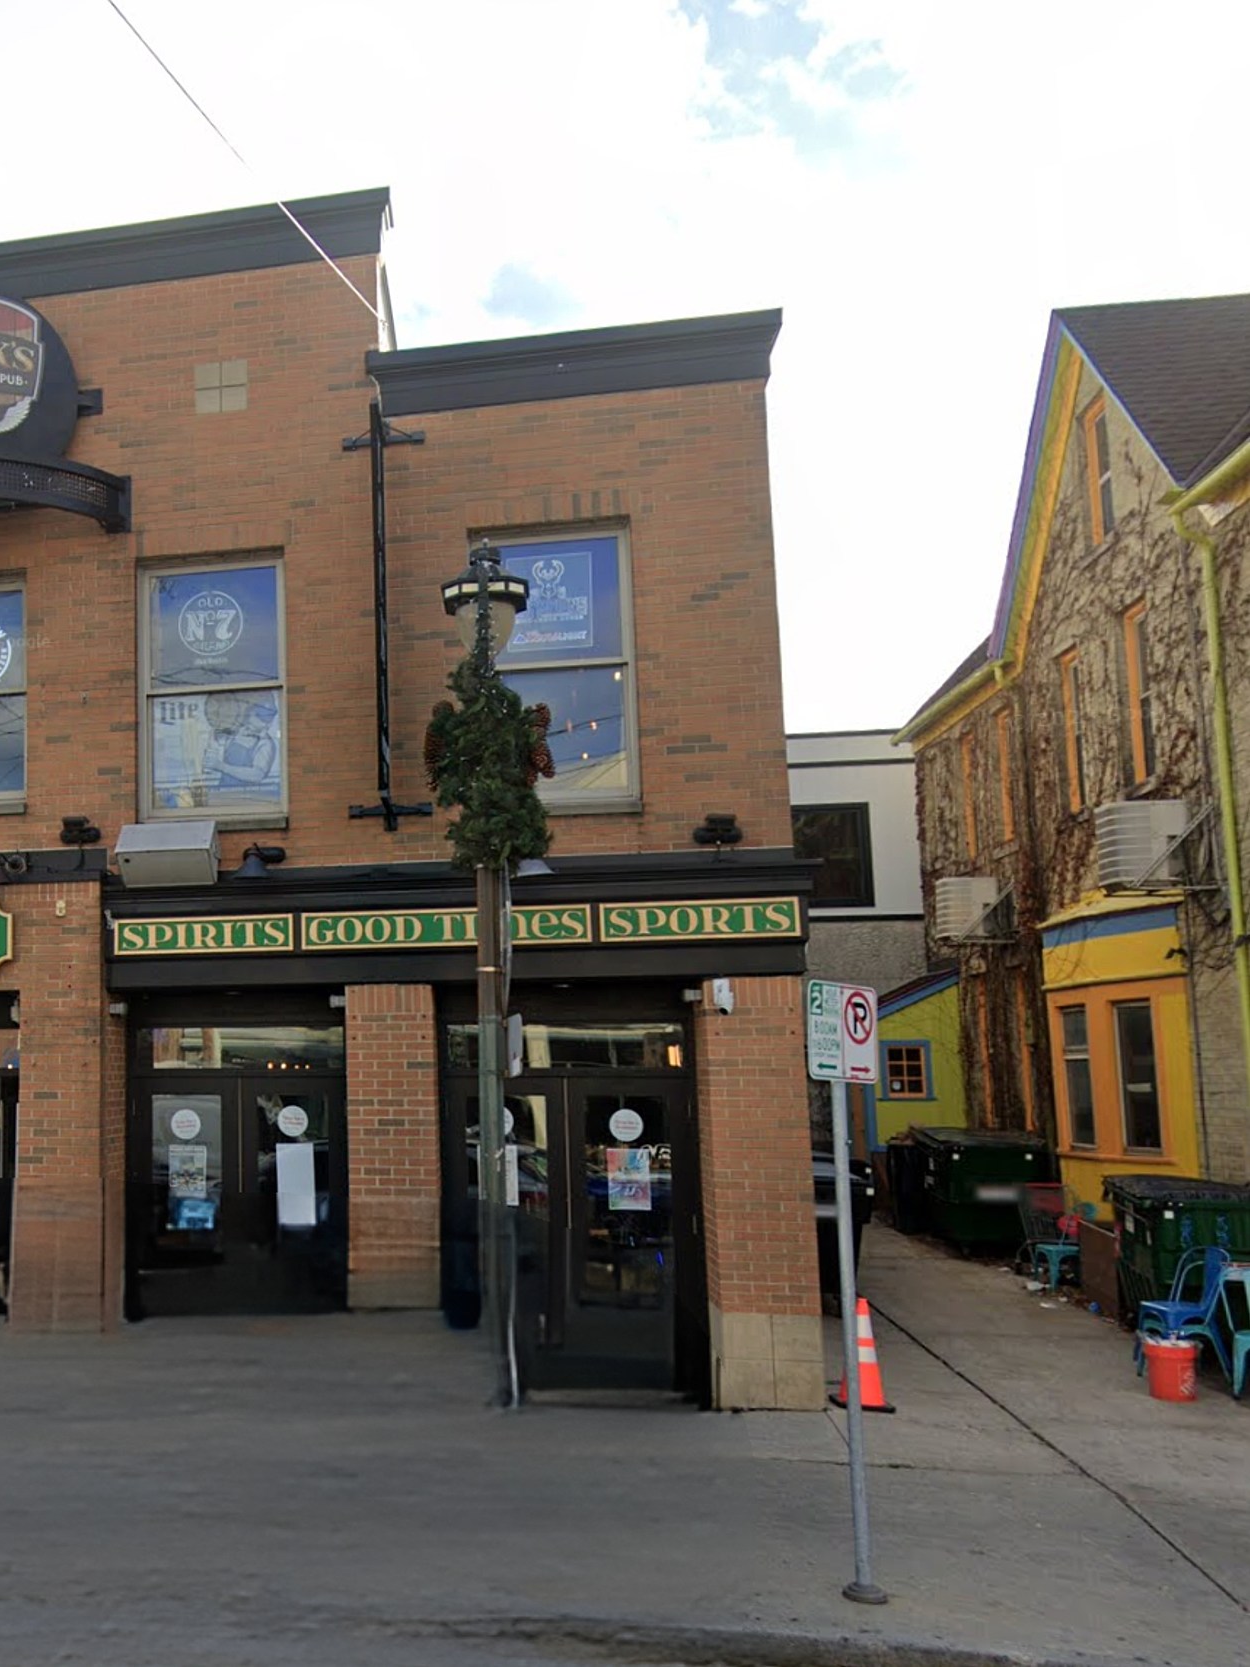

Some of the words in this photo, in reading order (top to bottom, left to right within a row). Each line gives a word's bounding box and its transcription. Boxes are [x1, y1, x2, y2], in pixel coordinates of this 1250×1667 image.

[0, 373, 24, 386] PUB
[308, 915, 423, 944] GOOD
[608, 901, 792, 936] SPORTS
[122, 919, 286, 949] SPIRITS
